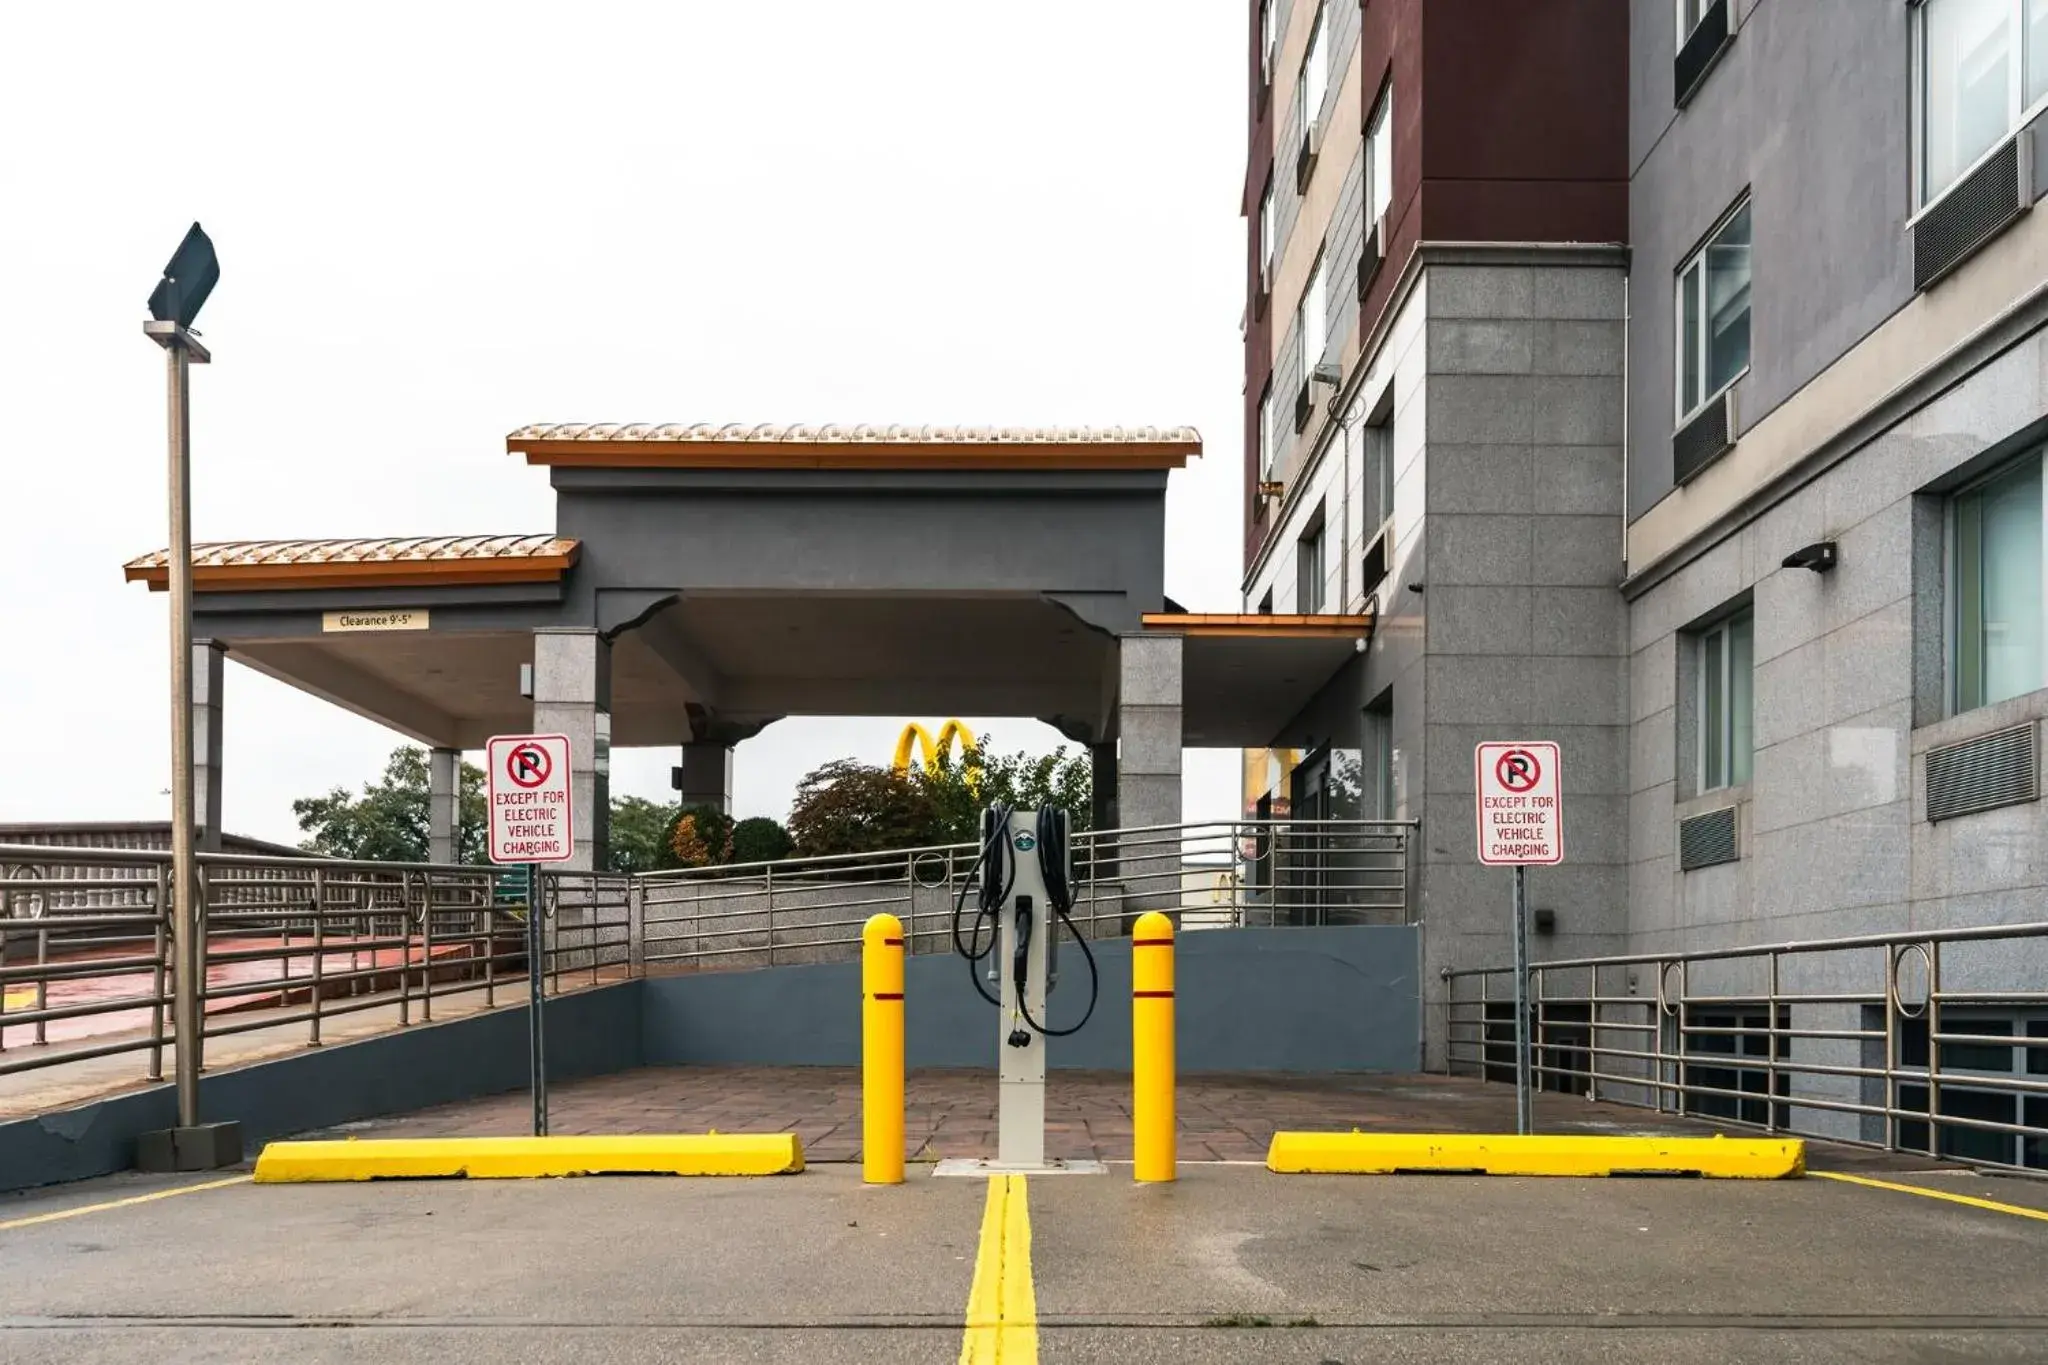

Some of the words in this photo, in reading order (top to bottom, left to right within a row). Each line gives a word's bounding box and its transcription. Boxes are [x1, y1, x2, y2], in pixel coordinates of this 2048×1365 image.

[340, 615, 387, 627] Clearance
[496, 792, 538, 805] EXCEPT
[543, 791, 565, 804] FOR
[1484, 796, 1527, 809] EXCEPT
[1532, 796, 1554, 808] FOR
[504, 808, 557, 821] ELECTRIC
[1493, 812, 1546, 824] ELECTRIC
[507, 824, 555, 837] VEHICLE
[1496, 828, 1544, 840] VEHICLE
[503, 841, 560, 854] CHARGING
[1492, 844, 1549, 856] CHARGING
